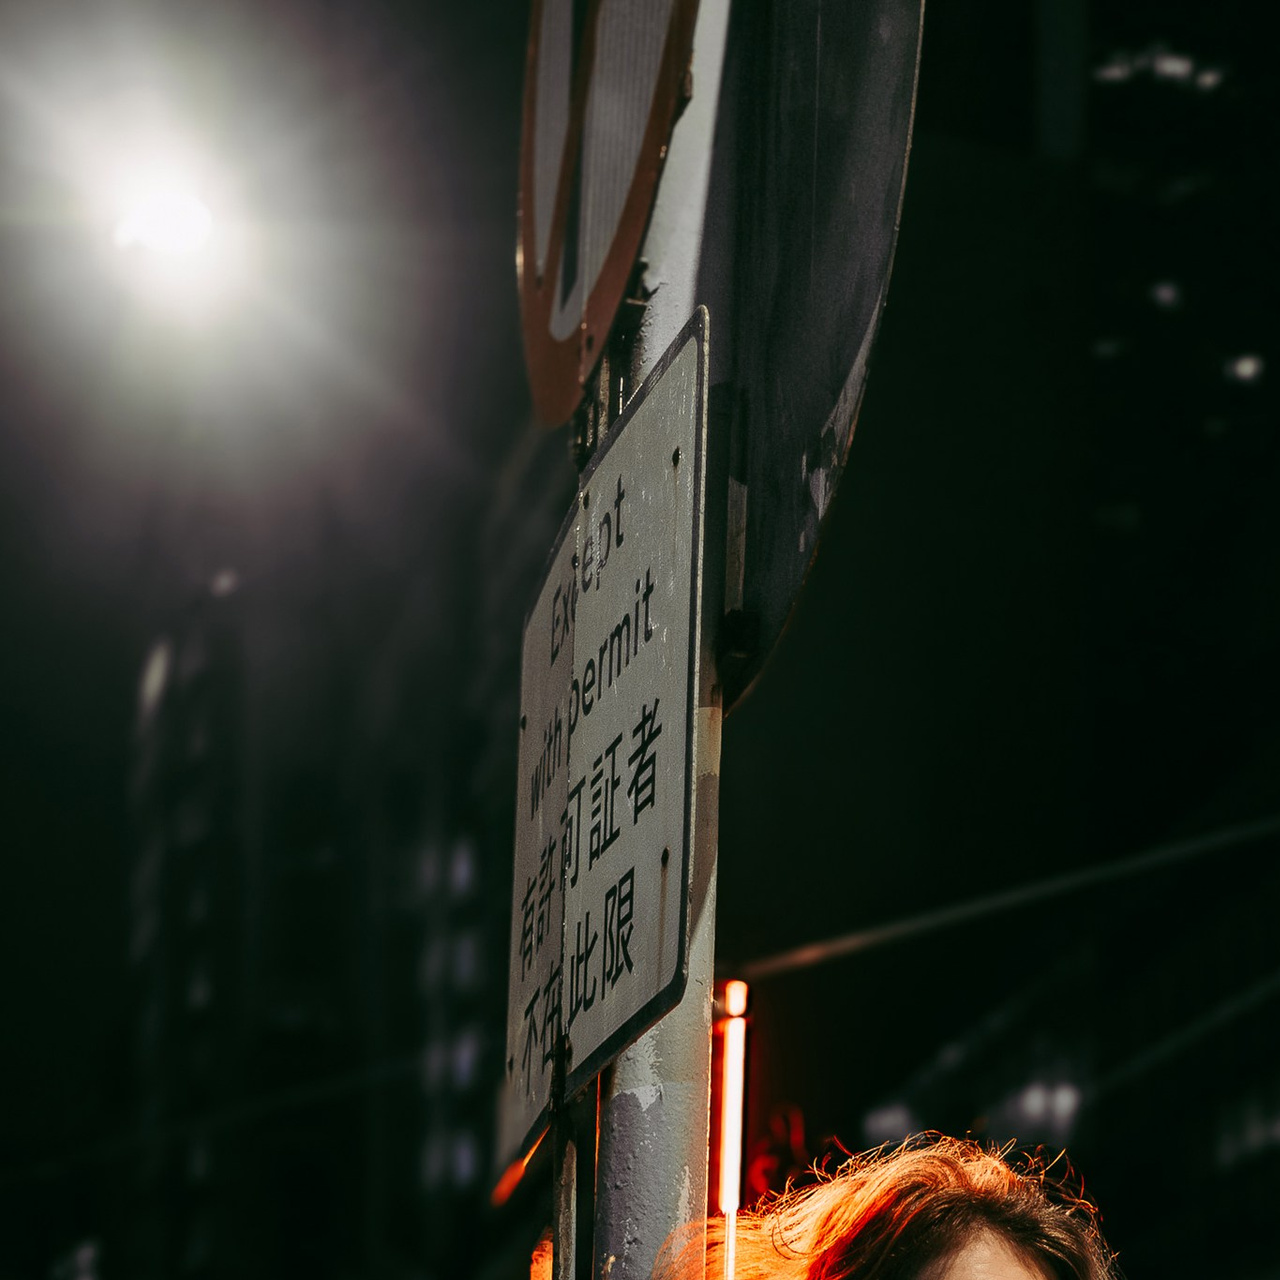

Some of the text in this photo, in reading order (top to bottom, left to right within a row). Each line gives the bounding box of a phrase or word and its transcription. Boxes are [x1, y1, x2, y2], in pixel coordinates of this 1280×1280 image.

[549, 473, 626, 667] Except
[530, 567, 655, 821] with permit
[520, 697, 663, 983] 有許可証者
[521, 865, 635, 1097] 不在此限
